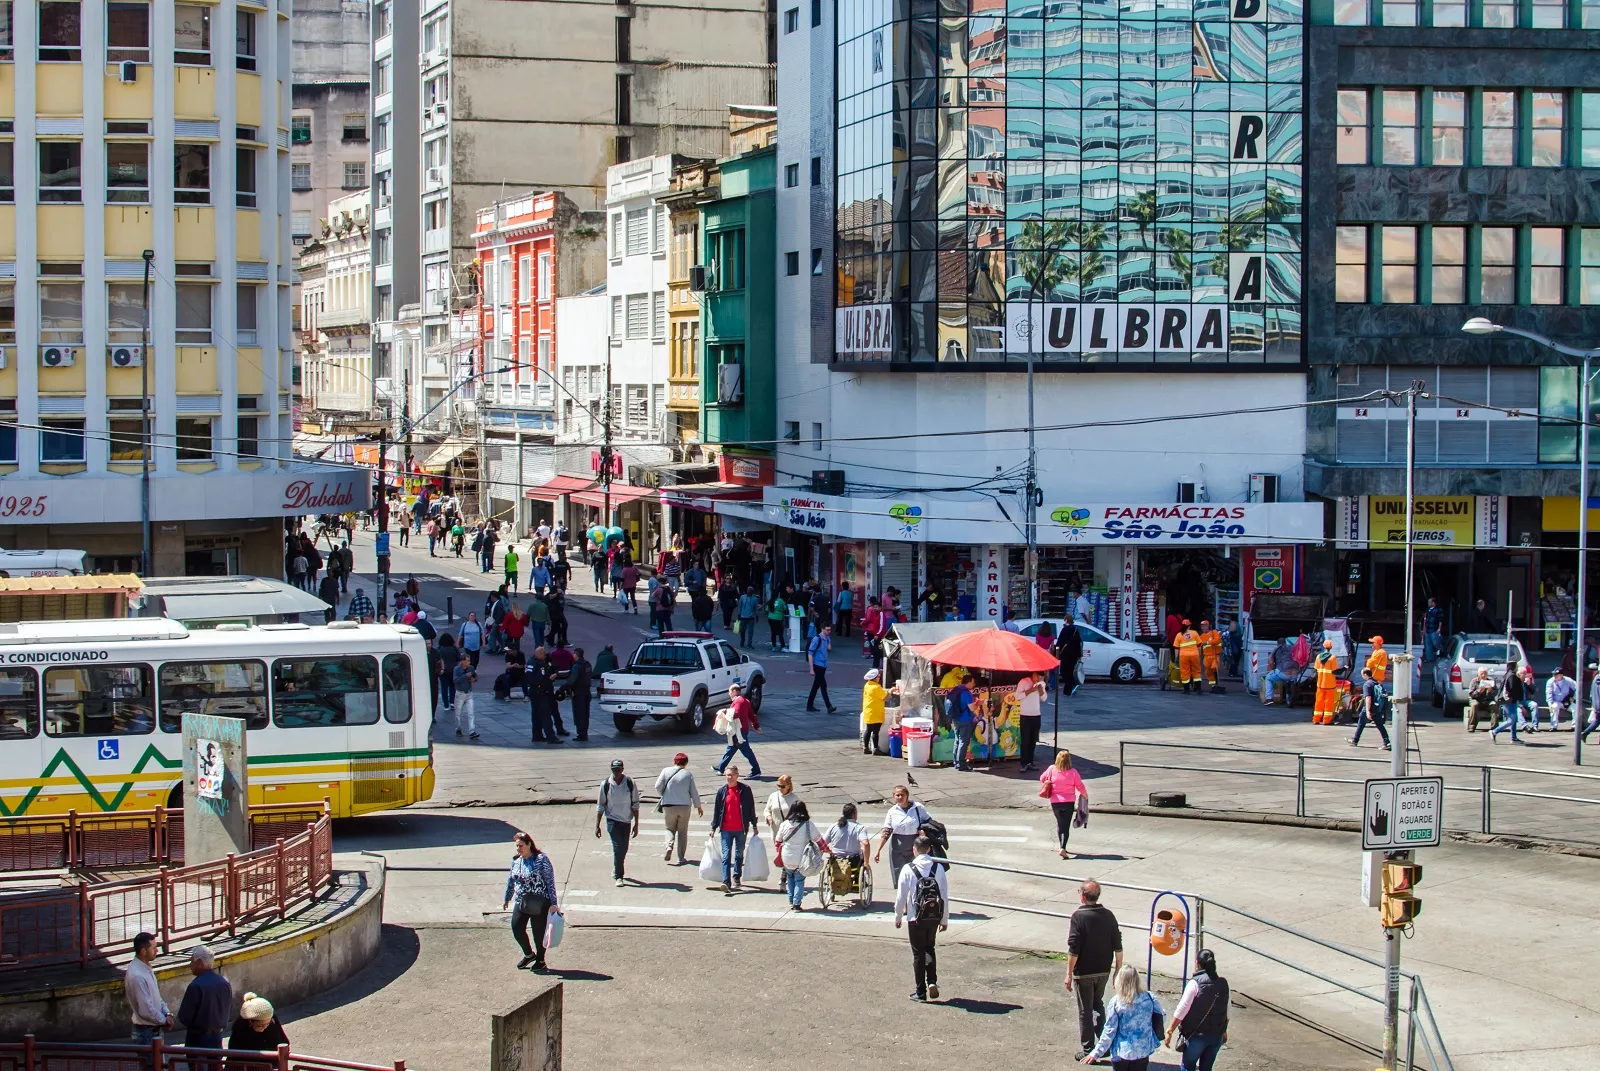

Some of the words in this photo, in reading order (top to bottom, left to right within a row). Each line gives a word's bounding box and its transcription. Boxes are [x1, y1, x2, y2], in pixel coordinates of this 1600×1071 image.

[845, 308, 891, 349] ULBRA
[1048, 308, 1223, 349] ULBRA
[282, 480, 353, 508] Dabdab
[790, 509, 805, 526] São
[806, 512, 826, 529] João
[1104, 504, 1245, 519] FARMÁCIAS
[1101, 519, 1162, 539] São
[1170, 519, 1245, 539] João
[987, 549, 999, 616] FARMÁC
[1123, 550, 1132, 640] FARMÁCIA
[8, 651, 108, 663] CONDICIONADO
[1400, 786, 1427, 795] APERTE
[1429, 786, 1435, 794] O
[1401, 800, 1426, 810] BOTÃO
[1399, 815, 1433, 824] AGUARDE
[1400, 831, 1405, 839] O
[1407, 829, 1431, 839] VERDE
